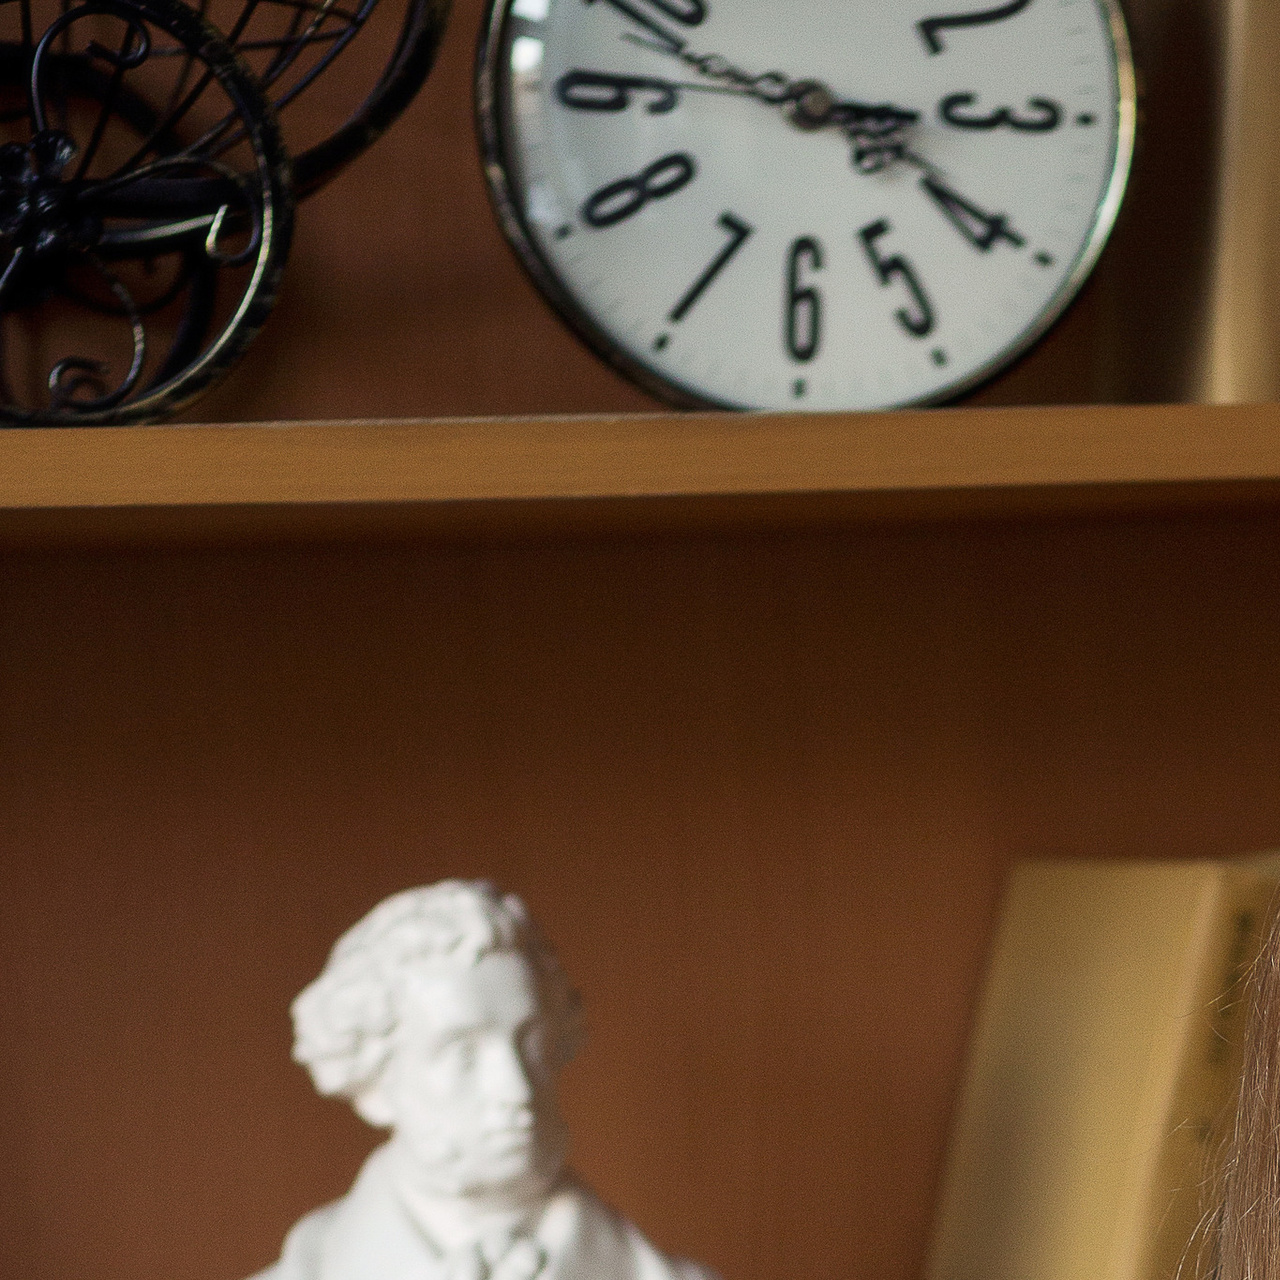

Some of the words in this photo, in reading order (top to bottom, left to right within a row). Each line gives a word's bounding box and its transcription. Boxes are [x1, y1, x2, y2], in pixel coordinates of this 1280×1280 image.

[556, 69, 678, 115] 9
[938, 91, 1062, 132] 3
[582, 152, 696, 228] 8
[919, 174, 1027, 254] 4
[670, 210, 755, 322] 7
[785, 234, 824, 363] 6
[858, 218, 937, 337] 5
